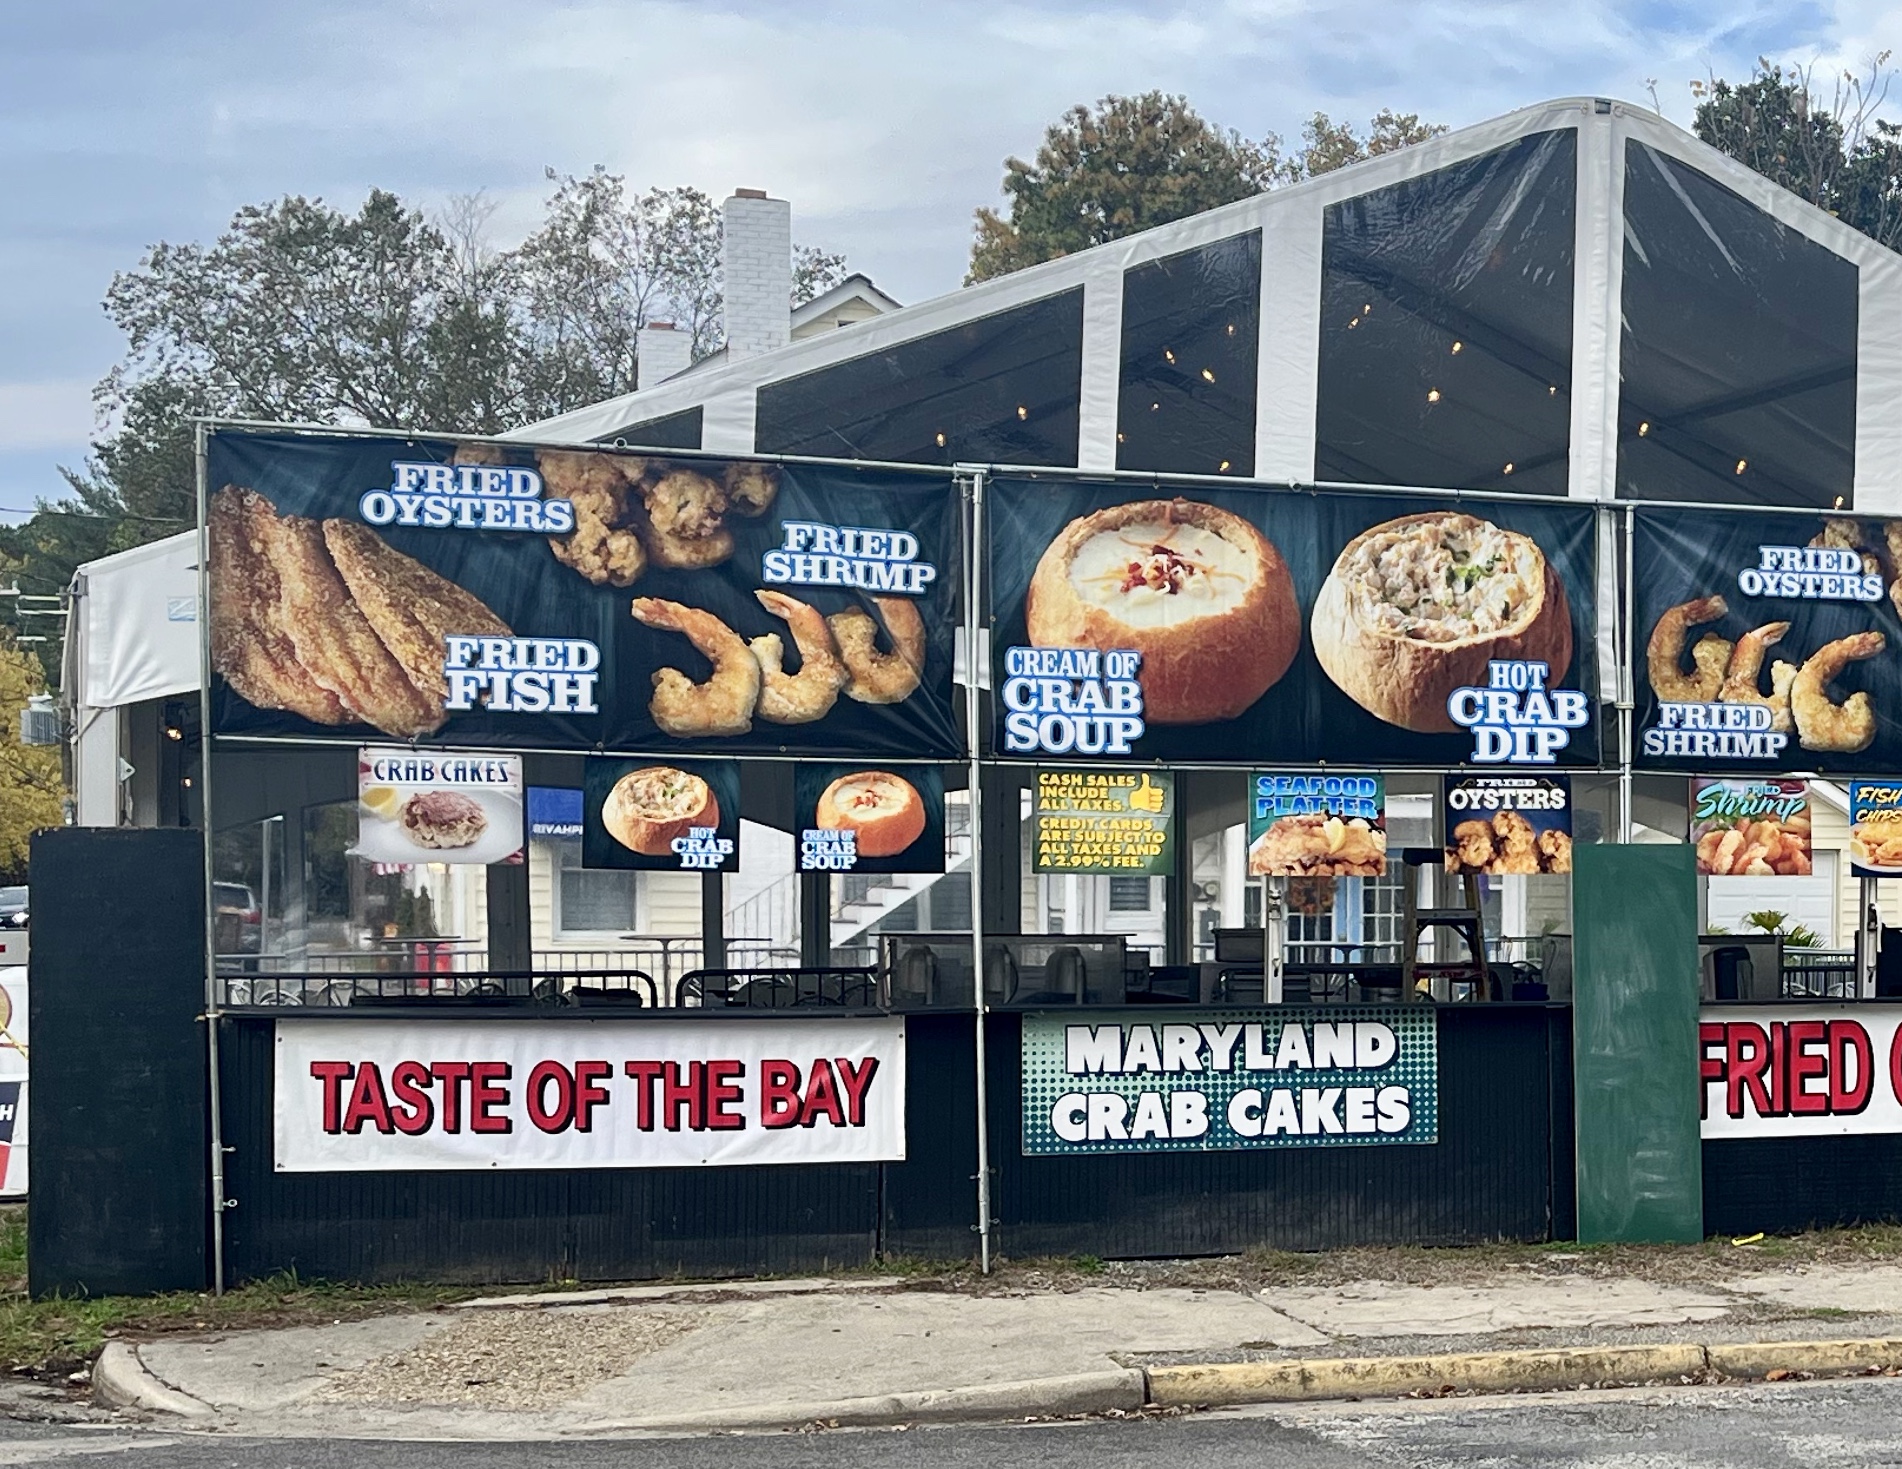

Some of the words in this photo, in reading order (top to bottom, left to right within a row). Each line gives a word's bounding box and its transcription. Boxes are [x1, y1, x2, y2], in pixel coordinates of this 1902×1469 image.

[391, 462, 541, 499] FRIED
[361, 491, 573, 532] OYSTERS
[782, 522, 918, 560] FRIED
[763, 552, 936, 592] SHRIMP
[1760, 547, 1862, 574] FRIED
[1738, 570, 1883, 601] OYSTERS
[446, 637, 598, 670] FRIED
[1006, 647, 1098, 678] CREAM
[1104, 648, 1139, 678] OF
[1490, 661, 1548, 691] HOT
[446, 671, 598, 713] FISH
[1003, 677, 1143, 715] CRAB
[1448, 690, 1589, 728] CRAB
[1659, 703, 1772, 731] FRIED
[1004, 715, 1143, 753] SOUP
[1472, 726, 1569, 763] DIP
[1643, 728, 1787, 758] SHRIMP
[374, 759, 435, 781] CRAB
[440, 760, 509, 782] CAKES
[1039, 773, 1083, 785] CASH
[1087, 774, 1136, 786] SALES
[1476, 778, 1538, 787] FRIED
[1039, 786, 1108, 799] INCLUDE
[1257, 776, 1377, 797] SEAFOOD
[1449, 788, 1565, 810] OYSTERS
[1745, 784, 1781, 796] FRIED
[1039, 798, 1068, 810] ALL
[1071, 799, 1125, 811] TAXES.
[1257, 796, 1377, 819] PLATTER
[1696, 781, 1807, 824] Shrimp
[1856, 809, 1902, 823] CHIPS
[689, 828, 716, 839] HOT
[802, 829, 839, 842] CREAM
[841, 830, 855, 842] OF
[1039, 818, 1093, 830] CREDIT
[1099, 818, 1153, 830] CARDS
[1039, 830, 1071, 841] ARE
[1074, 830, 1141, 843] SUBJECT
[1144, 831, 1165, 843] TO
[671, 838, 733, 853] CRAB
[801, 841, 856, 855] CRAB
[1039, 843, 1068, 854] ALL
[1071, 843, 1121, 854] TAXES
[1125, 844, 1161, 855] AND
[680, 853, 724, 868] DIP
[801, 855, 857, 869] SOUP
[1039, 855, 1052, 866] A
[1054, 856, 1110, 867] 2.99%
[1113, 856, 1144, 867] FEE.
[1066, 1021, 1397, 1076] MARYLAND
[1700, 1019, 1874, 1119] FRIED
[310, 1060, 513, 1137] TASTE
[527, 1060, 612, 1133] OF
[626, 1060, 746, 1132] THE
[760, 1057, 880, 1128] BAY
[1051, 1089, 1210, 1142] CRAB
[1226, 1086, 1411, 1138] CAKES
